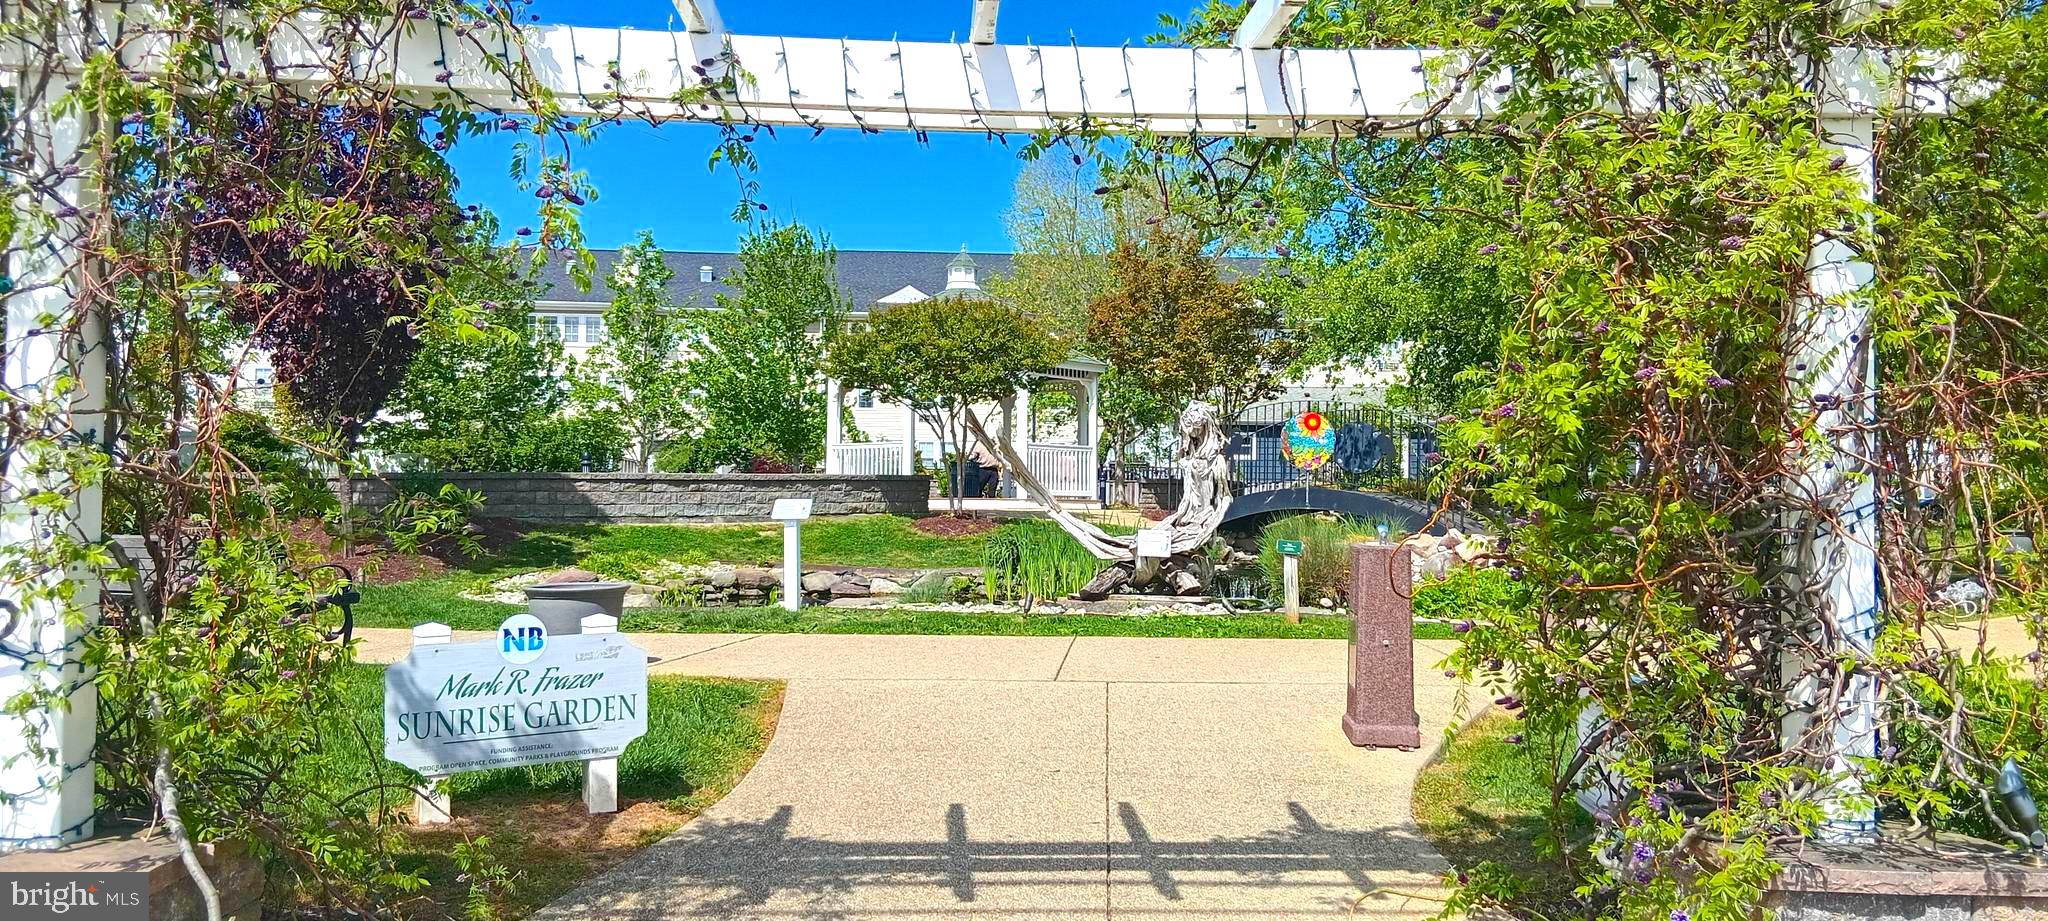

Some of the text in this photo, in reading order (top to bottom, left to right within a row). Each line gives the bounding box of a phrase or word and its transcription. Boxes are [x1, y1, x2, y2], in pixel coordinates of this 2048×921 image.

[503, 626, 544, 652] NB
[436, 666, 604, 701] Mark R. Frazer
[397, 693, 638, 745] SUNRISE GARDEN
[418, 763, 449, 772] PROGRAM
[450, 761, 467, 769] OPEN
[467, 759, 488, 768] SPACE,
[488, 756, 524, 765] COMMUNITY
[525, 753, 544, 761] PARKS
[549, 749, 591, 758] PLAYGROUNDS
[591, 745, 619, 754] PROGRAM
[490, 746, 518, 755] FUNDING
